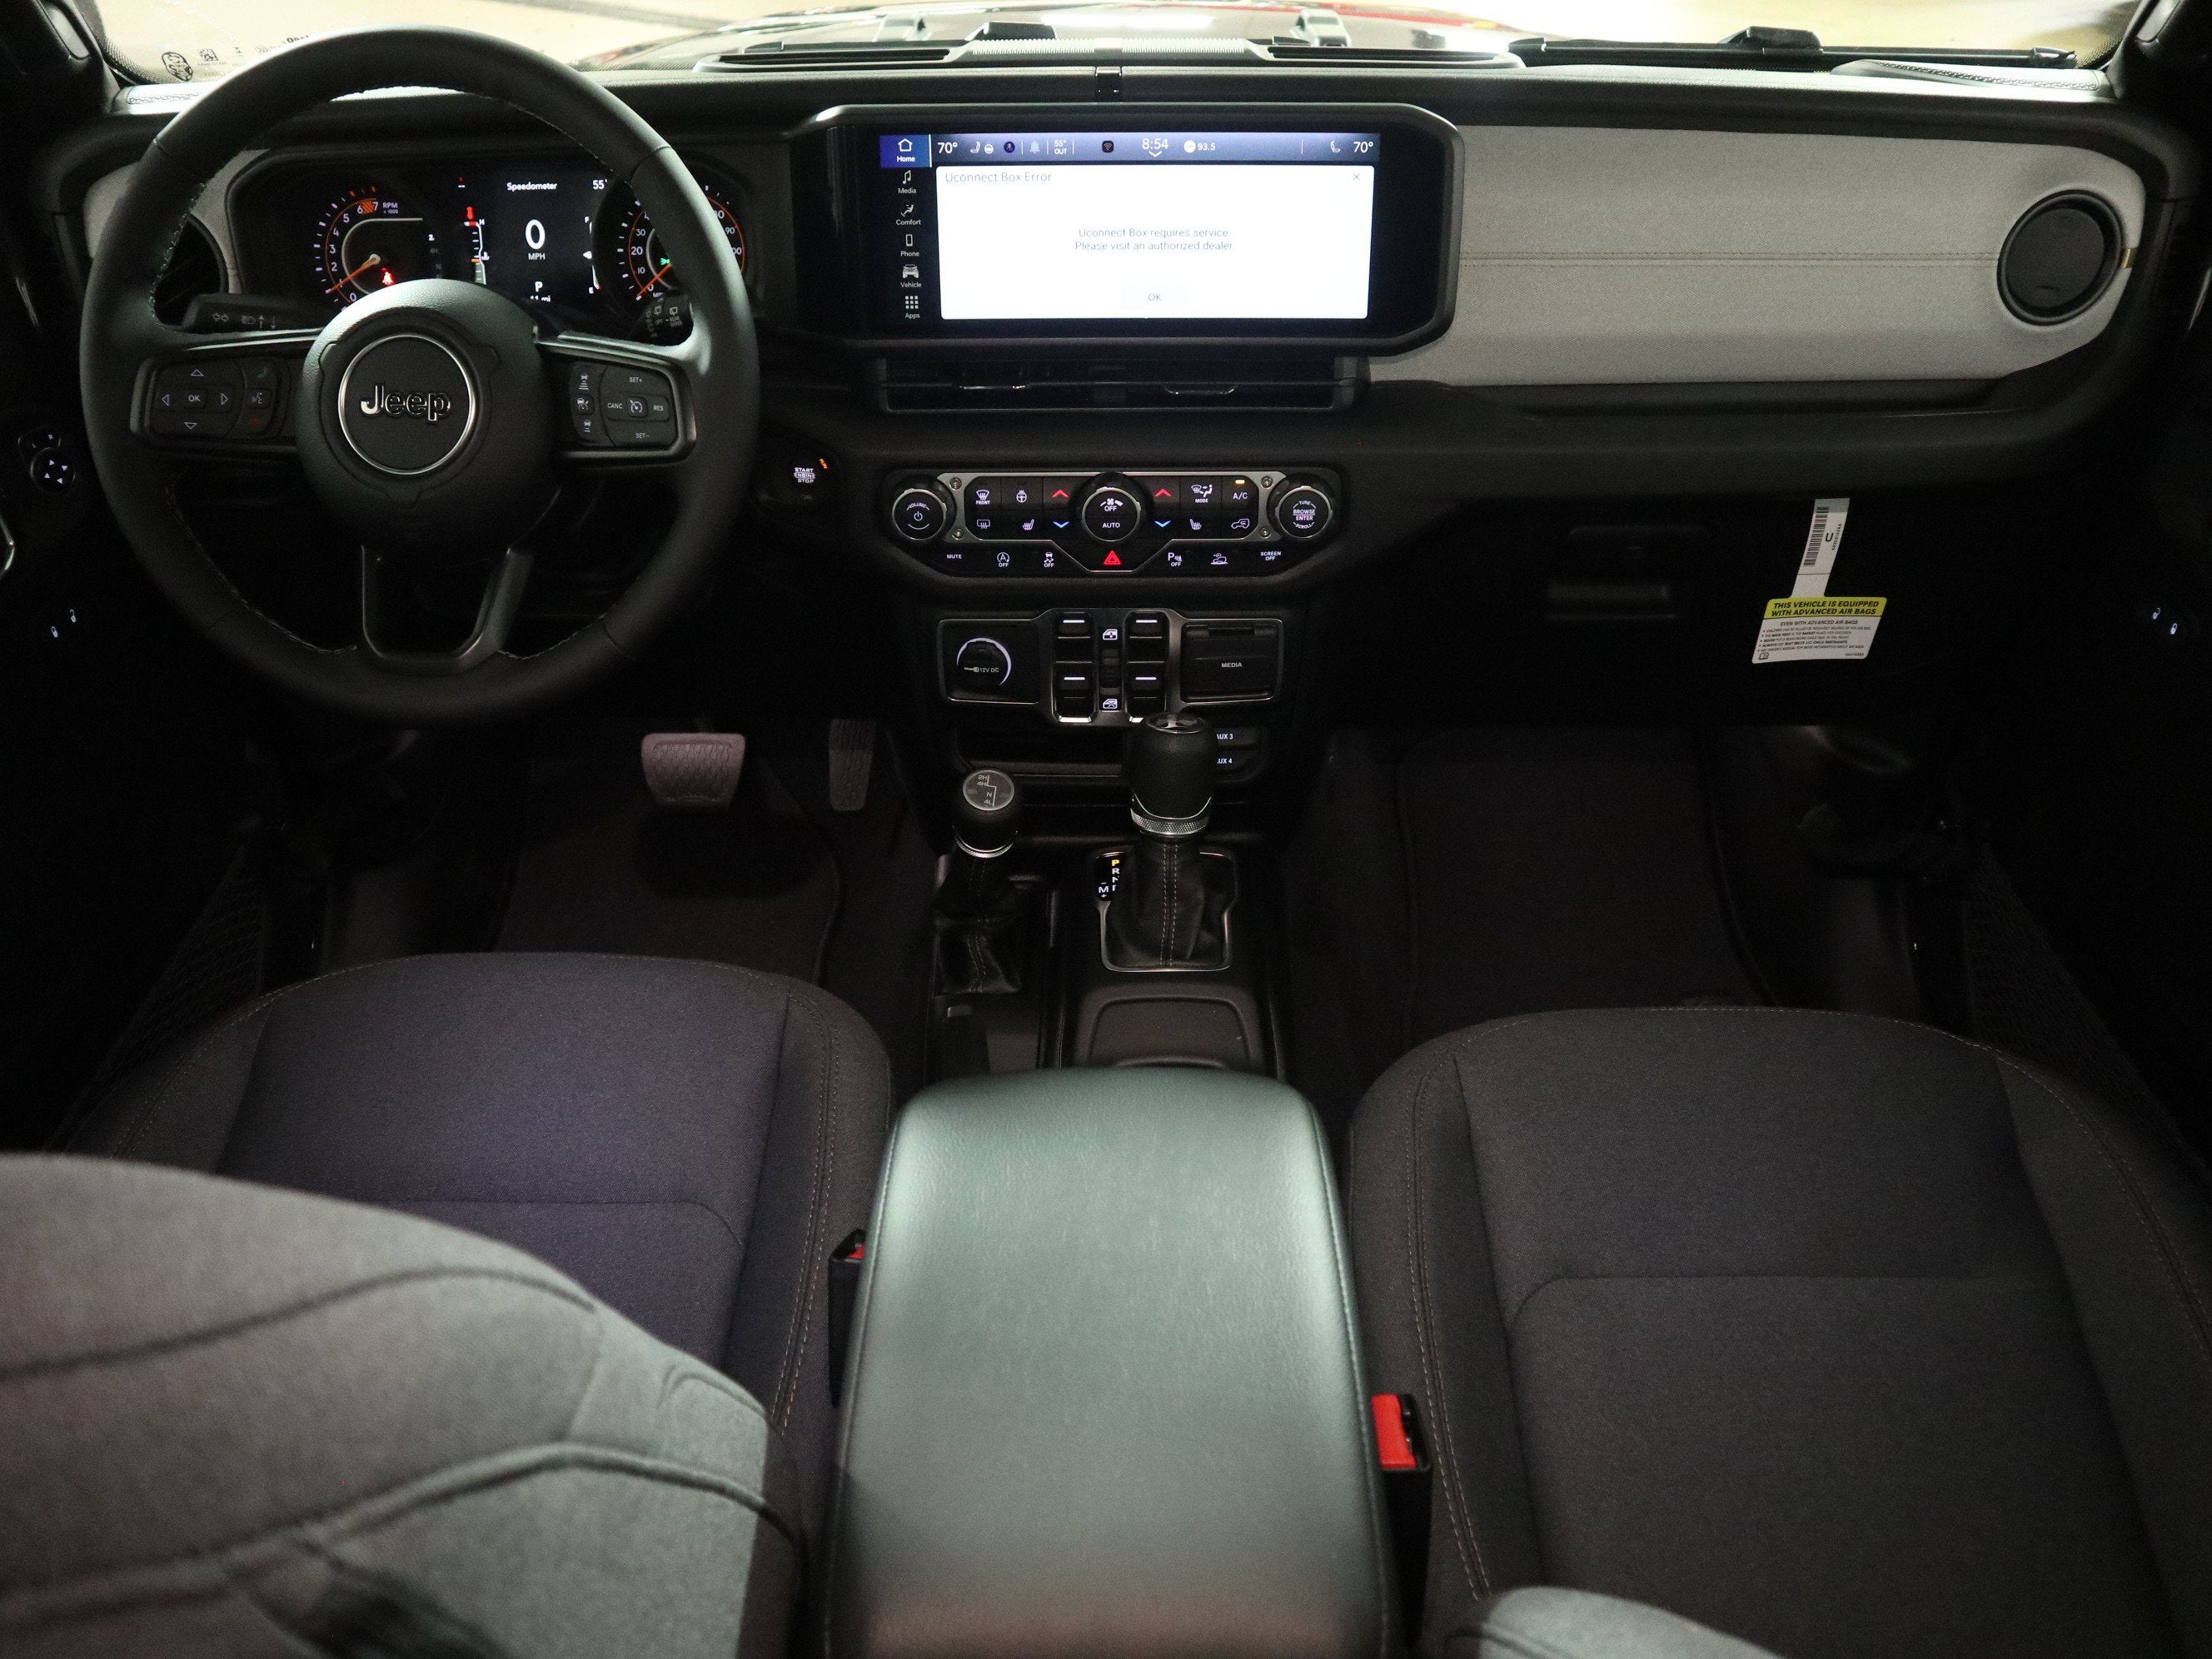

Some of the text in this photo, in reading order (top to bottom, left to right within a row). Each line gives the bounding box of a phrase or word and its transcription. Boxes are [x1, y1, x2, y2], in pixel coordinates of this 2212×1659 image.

[937, 142, 958, 154] 70°
[1142, 137, 1169, 150] 8:54
[1197, 142, 1216, 151] 93.5
[1353, 141, 1374, 153] 70°
[944, 172, 1053, 182] Uconnect Box Error
[506, 182, 558, 192] Speedometer
[525, 218, 546, 251] 0
[635, 228, 646, 237] 30
[1079, 228, 1126, 237] Uconnect
[1128, 228, 1148, 237] Box
[1150, 228, 1190, 238] requires
[630, 246, 644, 256] 20
[1075, 242, 1108, 251] Please
[1111, 242, 1130, 251] visit
[1148, 241, 1200, 251] authorized
[528, 252, 546, 261] MPH
[636, 267, 645, 275] 10
[536, 281, 543, 292] P
[188, 394, 201, 402] OK
[361, 385, 451, 421] Jeep
[1825, 533, 1834, 542] U
[1771, 609, 1793, 617] WITH
[1794, 608, 1837, 616] ADVANCED
[1111, 859, 1120, 867] P
[1098, 885, 1109, 894] M
